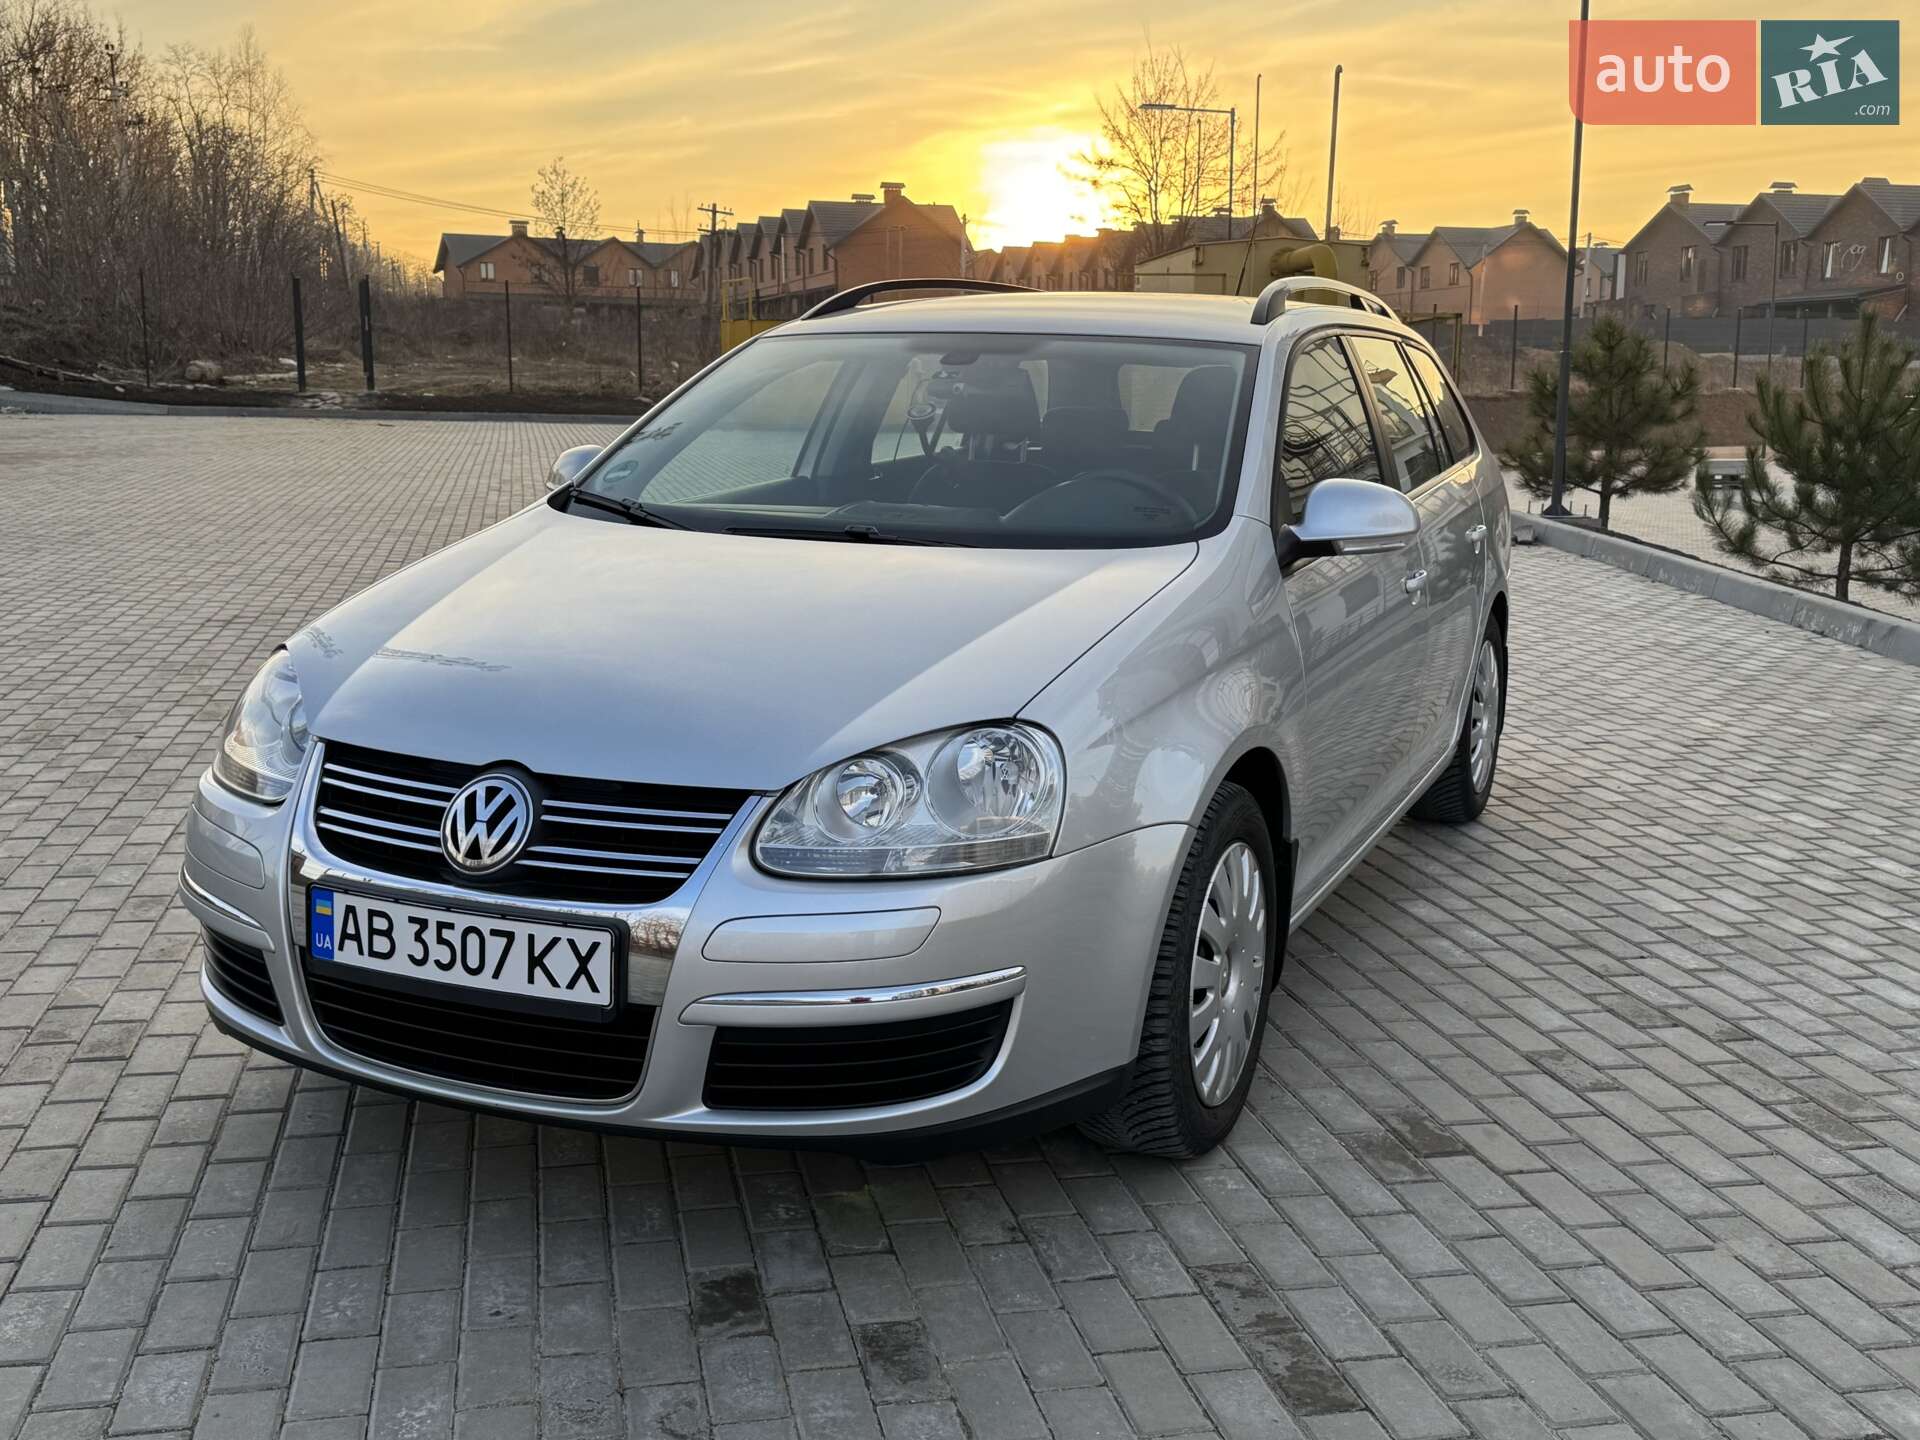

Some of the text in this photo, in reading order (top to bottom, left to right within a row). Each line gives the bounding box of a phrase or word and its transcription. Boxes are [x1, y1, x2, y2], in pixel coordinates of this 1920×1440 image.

[450, 779, 525, 865] VW
[315, 932, 332, 950] UA
[337, 904, 601, 994] AB 3507 KX
